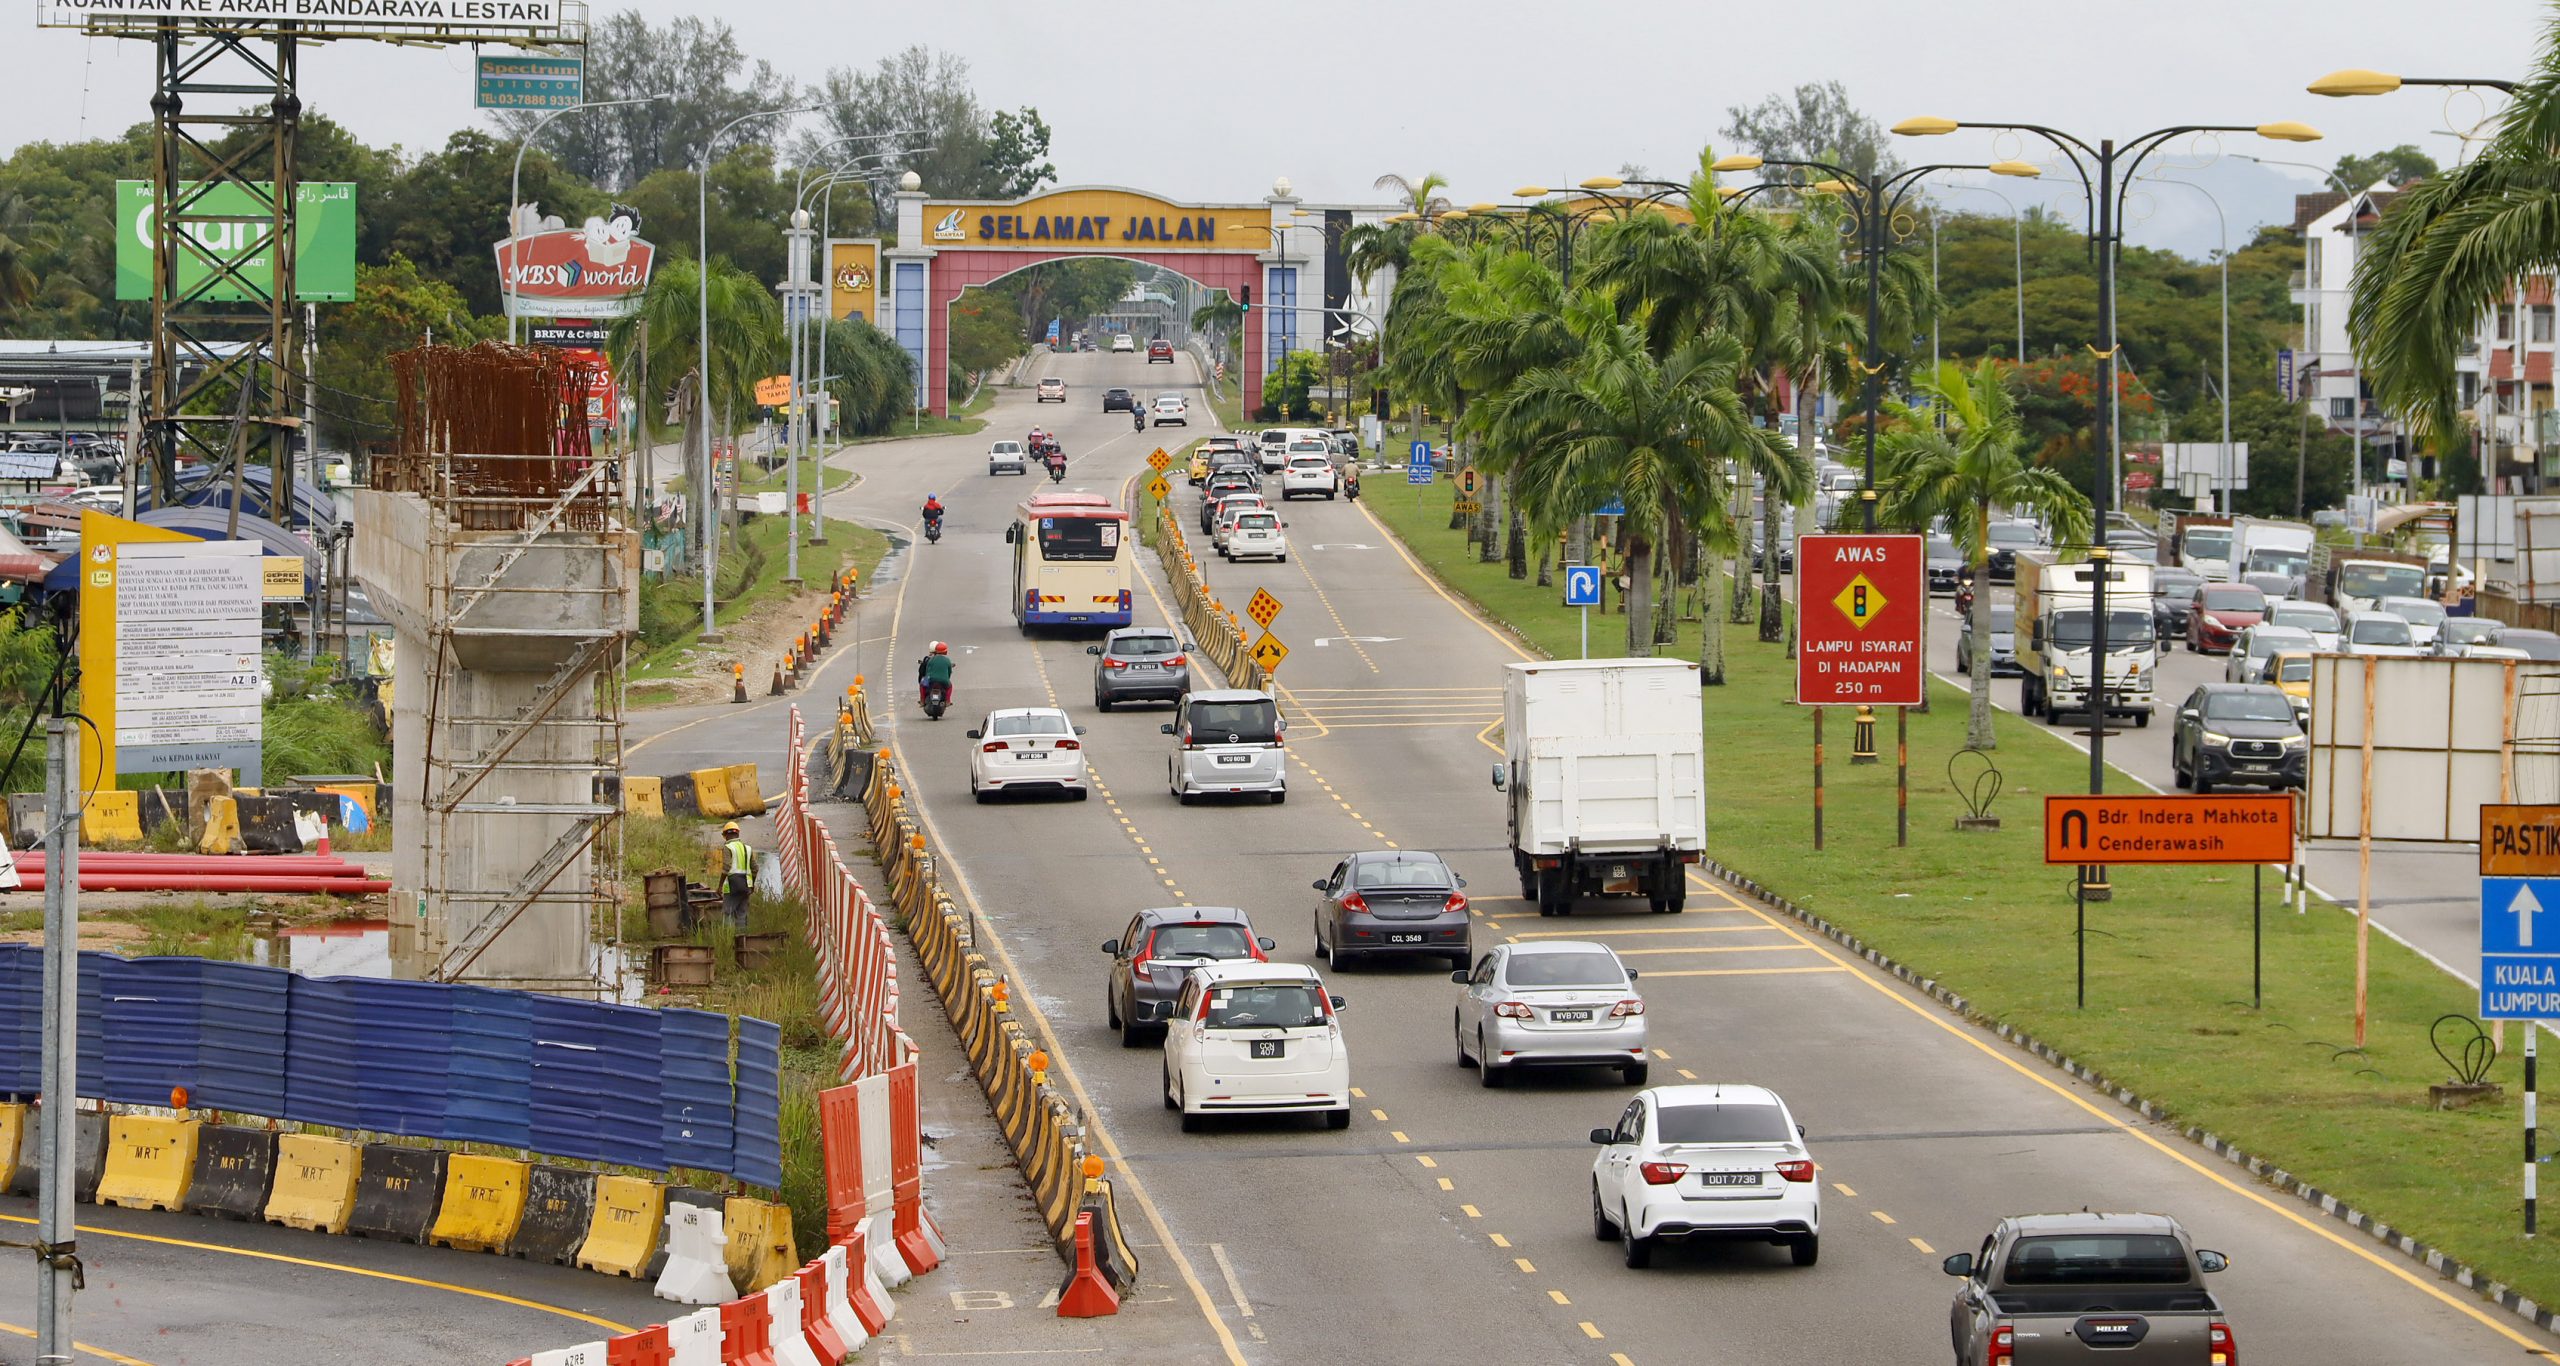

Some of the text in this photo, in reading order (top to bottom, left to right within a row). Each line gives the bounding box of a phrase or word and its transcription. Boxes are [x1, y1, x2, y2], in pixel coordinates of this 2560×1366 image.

[181, 0, 212, 11] KE
[219, 0, 288, 13] ARAH
[297, 0, 444, 18] BANDARAYA
[452, 3, 549, 20] LESTARI
[481, 62, 579, 76] Spectrum
[481, 92, 580, 106] TEL: 03-7886 9333
[979, 215, 1215, 241] SELAMAT JALAN
[505, 264, 643, 286] MBS world
[534, 330, 565, 339] BREW
[567, 330, 576, 338] &
[1455, 503, 1479, 512] AWAS
[1835, 547, 1887, 562] AWAS
[1806, 641, 1913, 652] LAMPU ISYARAT
[1818, 662, 1900, 673] DI HADAPAN
[1836, 682, 1882, 694] 250 m
[168, 754, 194, 762] KEPADA
[102, 808, 120, 818] MRT
[2140, 809, 2194, 824] Indera
[2204, 808, 2278, 824] Mahkota
[2099, 836, 2224, 851] Cenderawasih
[2496, 966, 2556, 985] KUALA
[2490, 992, 2560, 1012] LUMPUR
[1260, 1042, 1274, 1050] CCN
[135, 1147, 160, 1160] MRT
[220, 1156, 244, 1170] MRT
[301, 1166, 325, 1180] MRT
[1732, 1174, 1756, 1184] 7738
[386, 1176, 410, 1190] MRT
[470, 1188, 494, 1200] MRT
[546, 1200, 566, 1212] MRT
[614, 1210, 634, 1223] MRT
[684, 1214, 698, 1226] AZRB
[736, 1232, 752, 1244] MRT
[694, 1319, 707, 1334] AZRB
[638, 1338, 654, 1351] AZRB
[564, 1353, 585, 1366] AZRB
